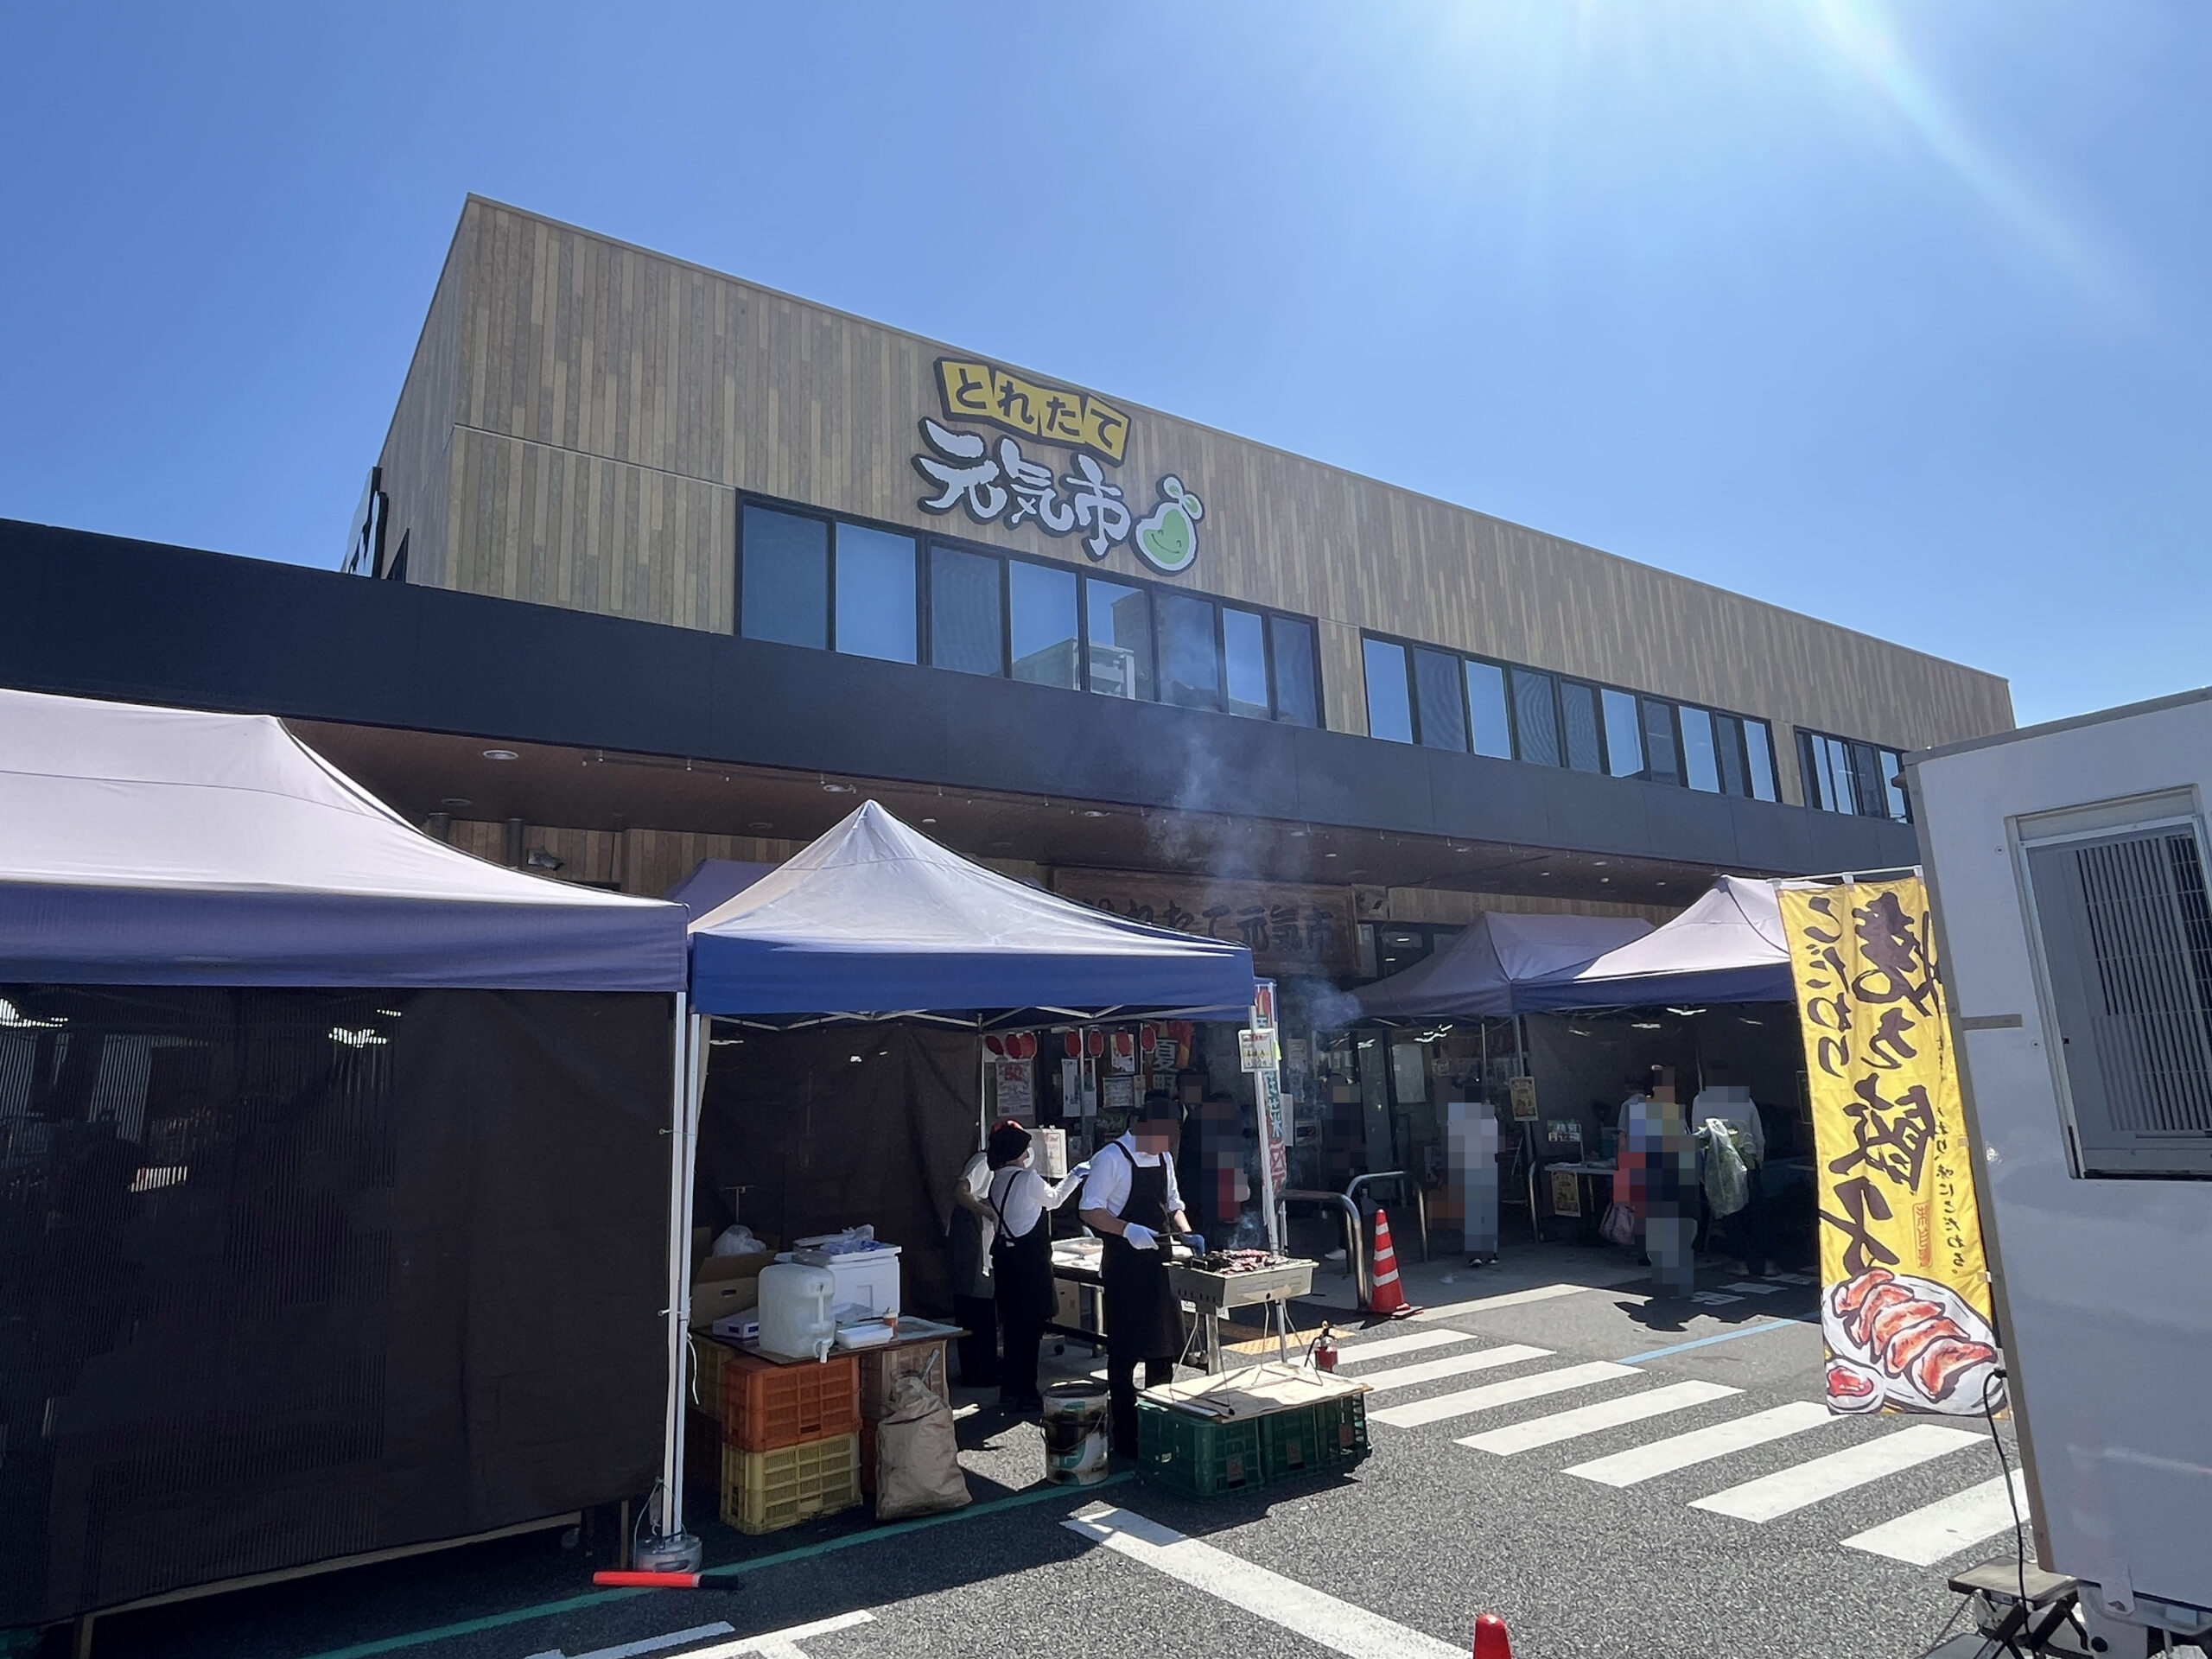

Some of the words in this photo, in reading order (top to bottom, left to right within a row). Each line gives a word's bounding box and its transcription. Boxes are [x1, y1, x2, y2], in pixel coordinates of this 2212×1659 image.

[956, 368, 1122, 448] とれたて
[918, 419, 1131, 556] 元気市
